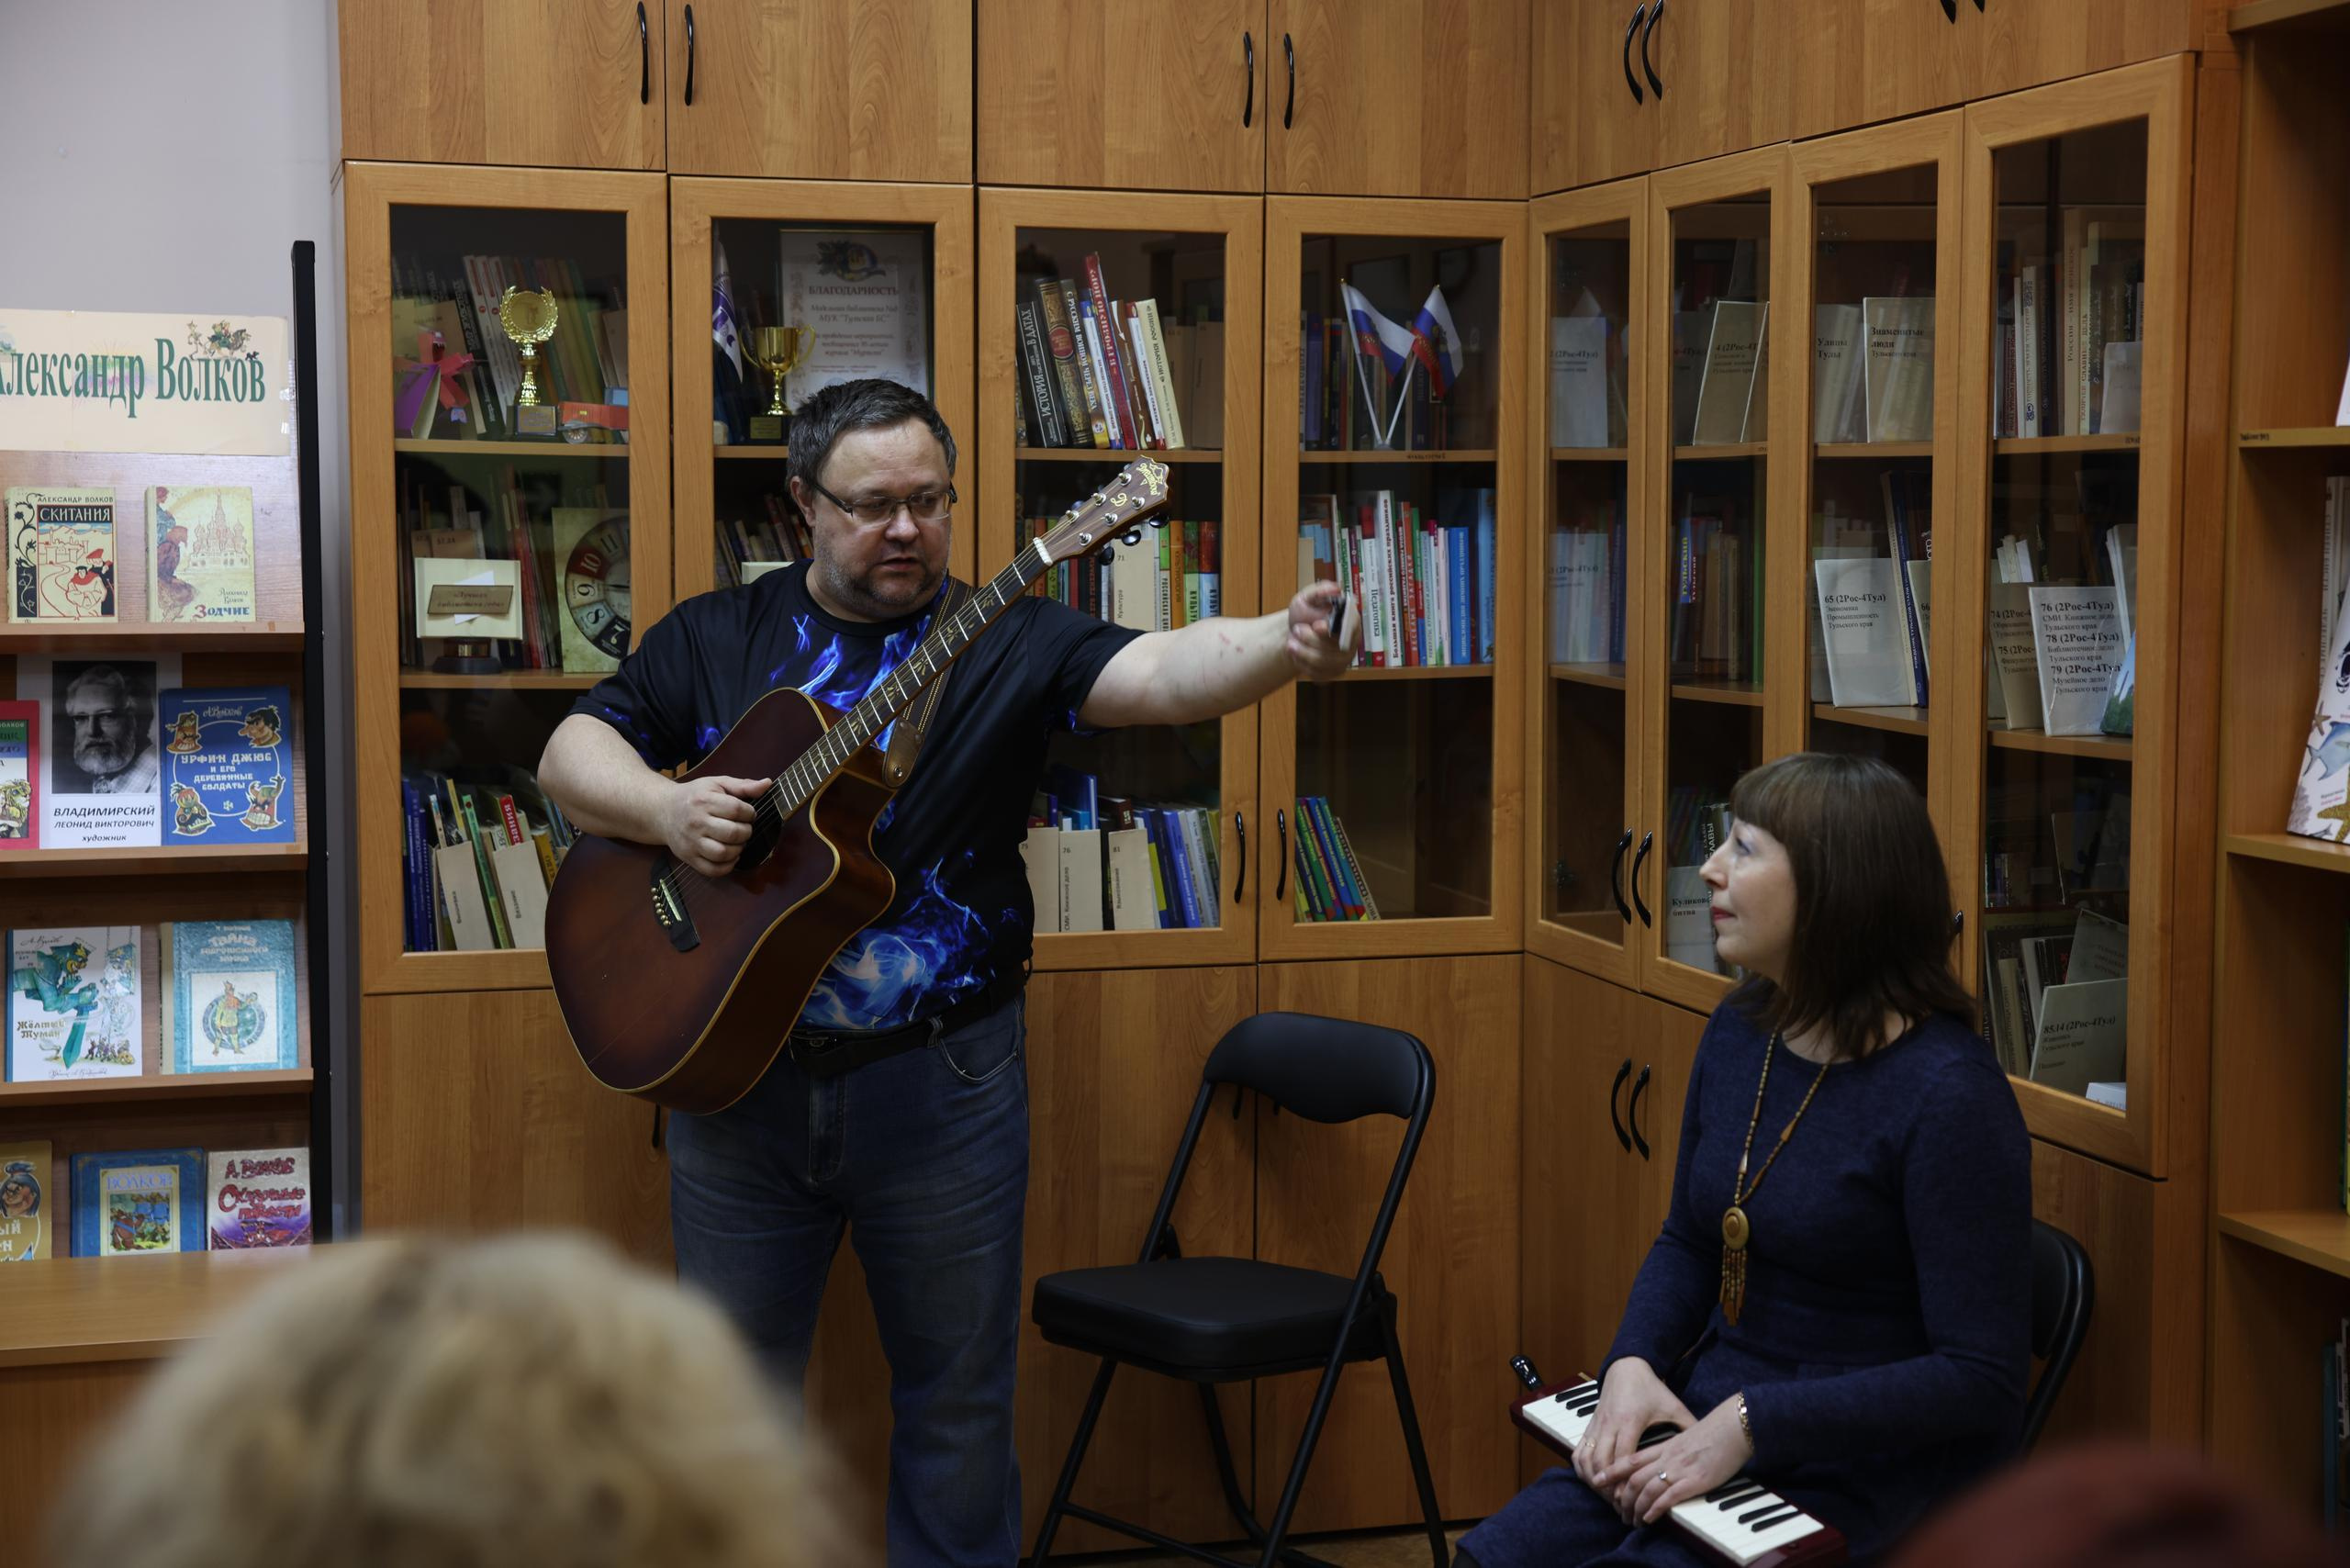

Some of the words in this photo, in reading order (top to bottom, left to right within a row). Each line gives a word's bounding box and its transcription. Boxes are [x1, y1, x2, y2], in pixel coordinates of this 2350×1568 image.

[809, 286, 899, 295] БЛАГОДАРНОСТЬ
[1021, 308, 1035, 337] ДАТАХ
[1147, 312, 1157, 341] РОССИИ
[1871, 327, 1924, 336] Знаменитые
[1027, 336, 1036, 346] В
[1818, 338, 1847, 347] Улицы
[1872, 341, 1895, 349] люди
[1068, 297, 1081, 333] РУССКИМ
[1075, 333, 1087, 360] ВОИНОМ
[1081, 361, 1091, 387] ЧЕРЕЗ
[1086, 388, 1097, 409] ВЕКА
[1153, 342, 1164, 375] ИСТОРИЯ
[1818, 350, 1841, 360] Тулы
[1110, 359, 1117, 367] В
[0, 352, 145, 418] лександр
[154, 338, 265, 402] Волков
[1034, 375, 1052, 418] ИСТОРИЯ
[39, 508, 110, 521] СКИТАНИЯ
[580, 553, 602, 573] 10
[1387, 549, 1395, 595] российских
[577, 584, 595, 596] 9
[1836, 594, 1886, 604] (2Рос-4Тул)
[1371, 588, 1380, 636] Педагогика
[2041, 603, 2053, 611] 76
[2055, 601, 2114, 612] (2Рос-4Тул)
[587, 609, 604, 624] 8
[1827, 613, 1879, 622] Промышленность
[2002, 610, 2031, 619] (2Рос-4
[1829, 622, 1859, 630] Тульского
[1908, 606, 1916, 635] ТУЛЬСКОЙ
[2044, 623, 2080, 632] Тульского
[610, 624, 624, 644] 7
[2046, 634, 2058, 643] 78
[2060, 633, 2120, 644] (2Рос-4Тул)
[1391, 622, 1399, 658] Большая
[2009, 645, 2035, 655] (2Рос-
[2051, 666, 2063, 674] 79
[182, 754, 226, 764] УРФИН
[231, 753, 272, 765] ДЖЮС
[194, 774, 253, 784] ДЕРЕВЯННЫЕ
[202, 782, 246, 791] СОЛДАТЫ
[53, 805, 155, 817] ВЛАДИМИРСКИЙ
[54, 821, 93, 829] ЛЕОНИД
[95, 820, 154, 828] ВИКТОРОВИЧ
[17, 1020, 65, 1031] Жёлтый
[2065, 1014, 2116, 1031] (2Рос-4Тул)
[21, 1030, 61, 1040] Туман
[107, 1172, 173, 1191] ВОЛКОВ
